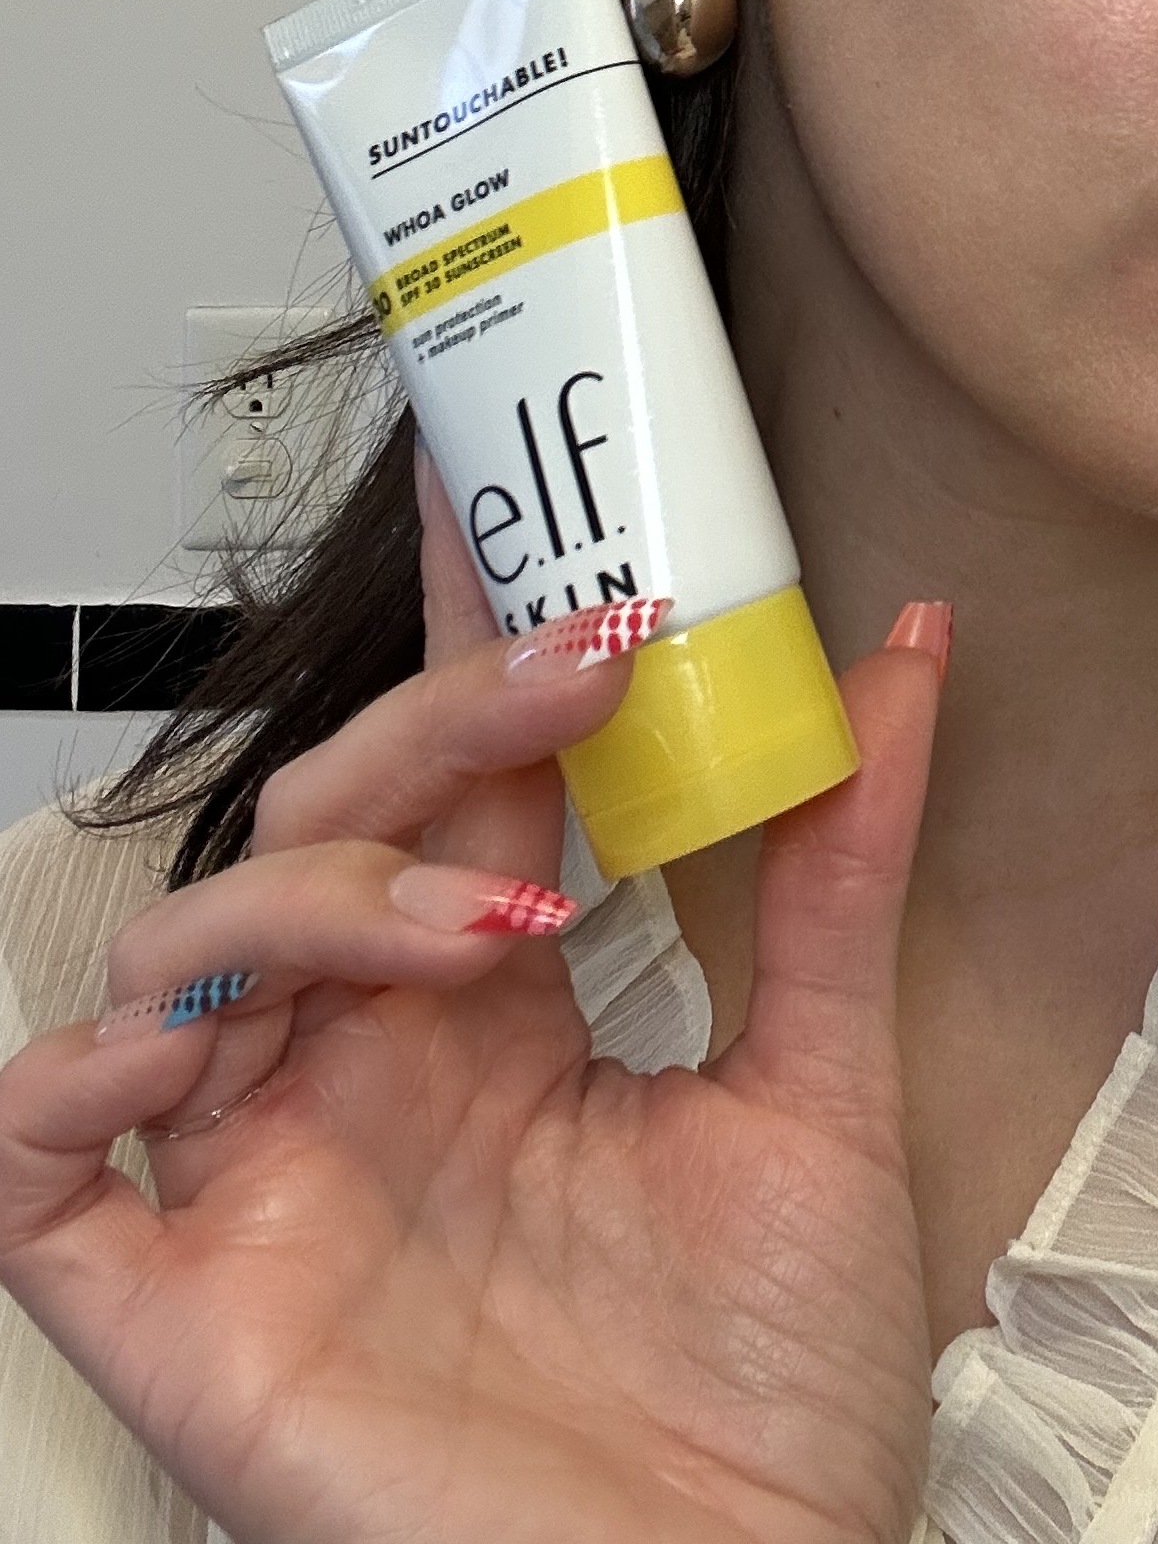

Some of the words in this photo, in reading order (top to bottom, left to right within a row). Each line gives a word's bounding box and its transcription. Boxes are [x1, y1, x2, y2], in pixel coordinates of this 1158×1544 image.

[368, 47, 569, 165] SUNTOUCHABLE!
[384, 204, 446, 247] WHOA
[451, 168, 509, 212] GLOW
[396, 260, 439, 290] BROAD
[442, 223, 511, 266] SPECTRUM
[401, 287, 420, 307] SPF
[445, 235, 522, 283] SUNSCREEN
[428, 325, 476, 358] makeup
[479, 302, 524, 336] primer
[435, 294, 502, 338] protection
[469, 370, 626, 584] e.l.f.
